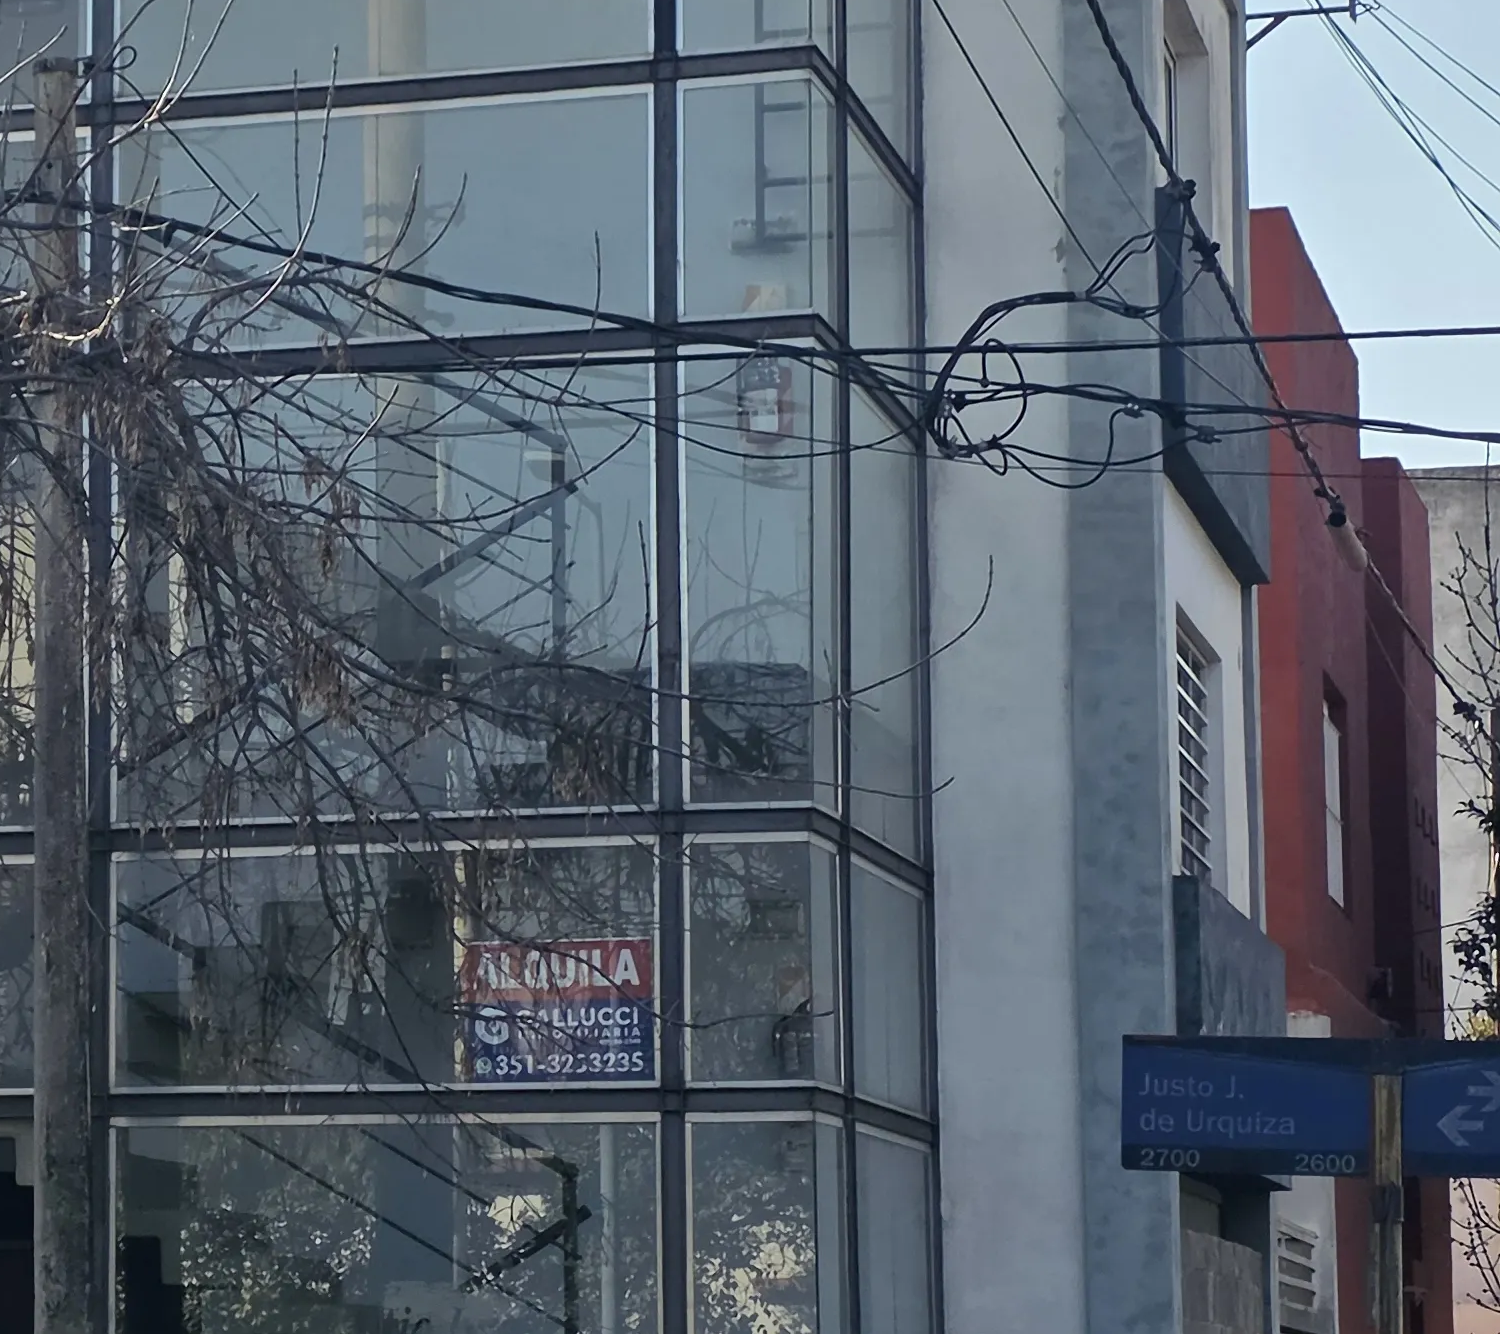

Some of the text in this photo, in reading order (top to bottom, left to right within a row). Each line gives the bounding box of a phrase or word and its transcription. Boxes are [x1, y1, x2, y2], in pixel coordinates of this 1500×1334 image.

[473, 947, 640, 990] ALQUILA
[1139, 1073, 1245, 1100] Justo J.
[1140, 1108, 1296, 1140] de Urquiza
[1140, 1147, 1356, 1174] 2700 2600
